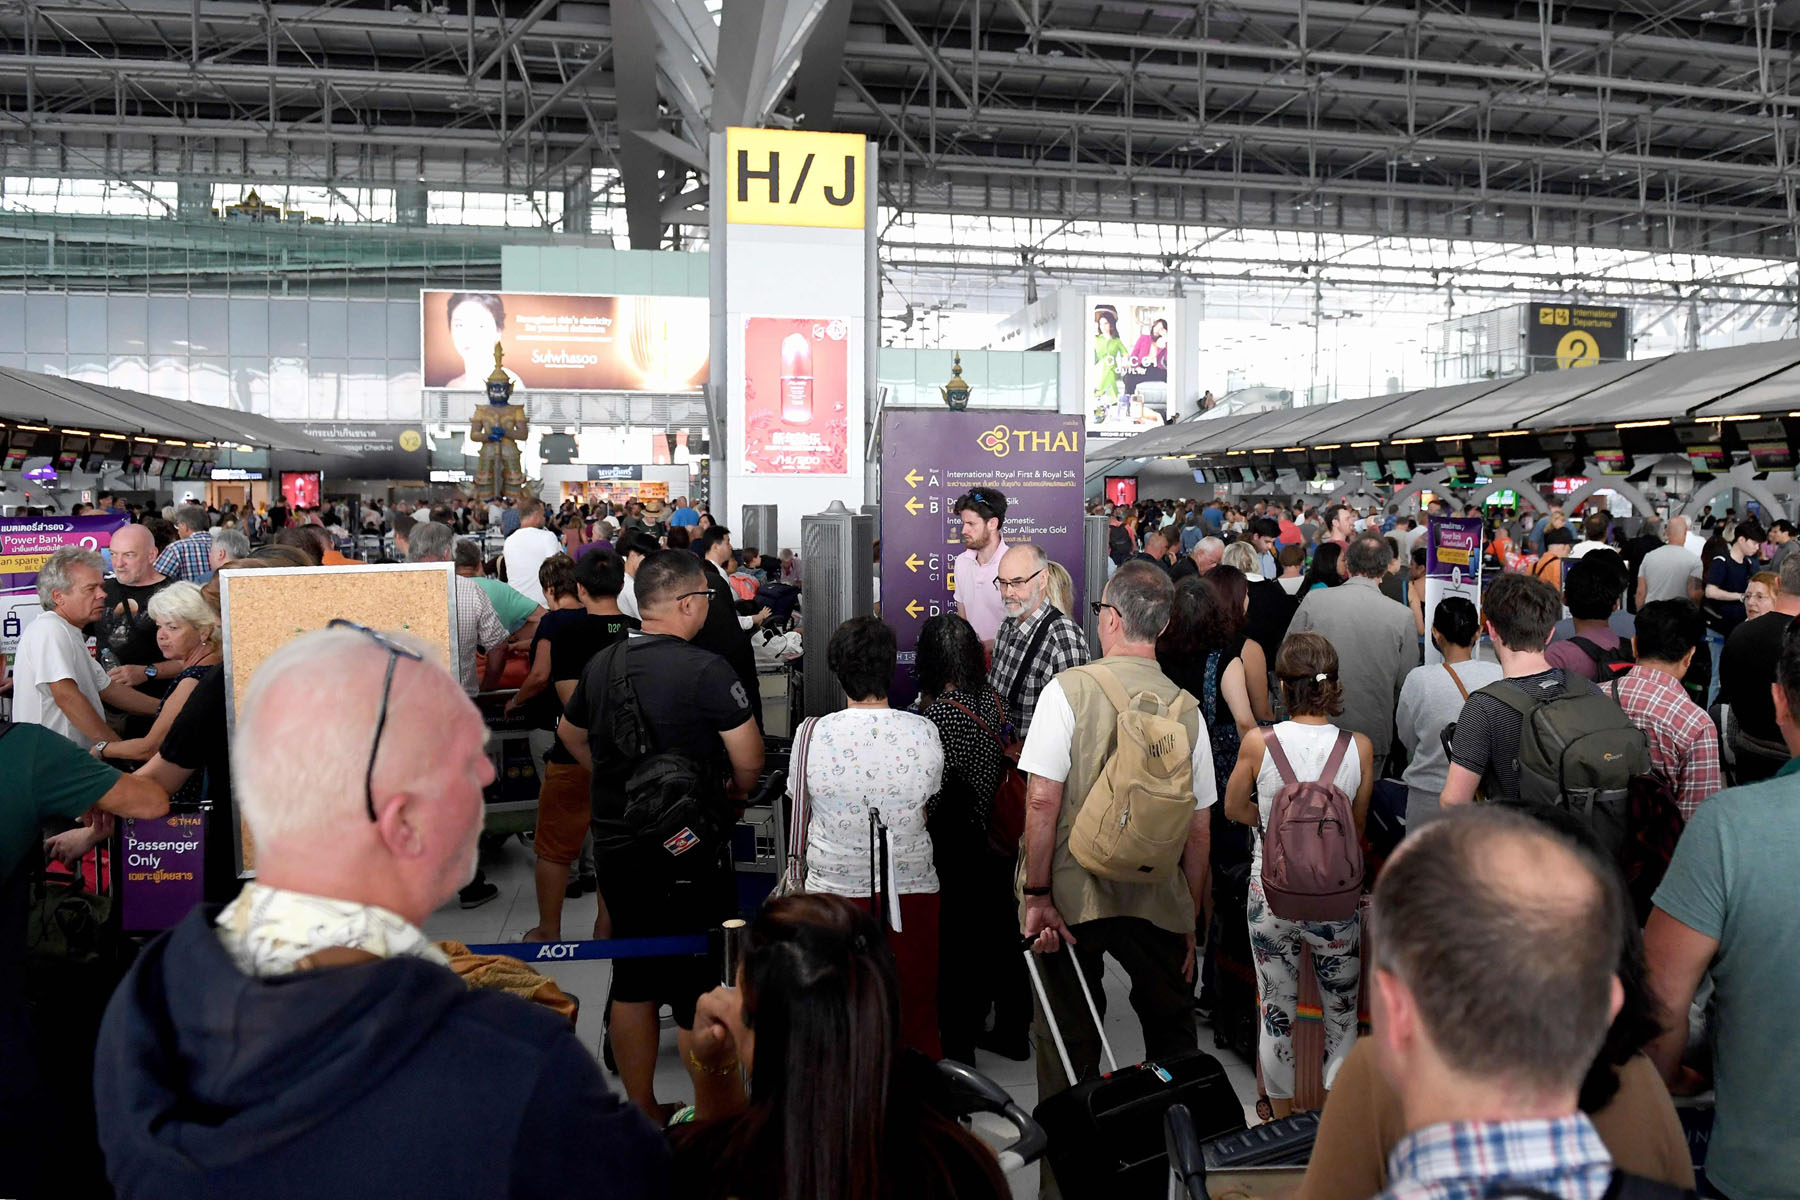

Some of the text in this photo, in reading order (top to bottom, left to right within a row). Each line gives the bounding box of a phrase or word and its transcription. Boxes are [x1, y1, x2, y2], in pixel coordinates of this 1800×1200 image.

[531, 349, 598, 365] Sulwhasoo
[1011, 429, 1079, 452] THAI
[928, 475, 939, 487] A
[946, 470, 1076, 480] International Royal First & Royal Silk
[1006, 497, 1019, 506] Silk
[929, 502, 939, 514] B
[1003, 526, 1067, 535] Star Alliance Gold
[4, 534, 64, 546] Power Bank
[14, 557, 39, 568] spare
[928, 558, 939, 571] C
[929, 573, 939, 582] C1
[929, 605, 940, 617] D
[729, 681, 749, 709] 8
[128, 838, 199, 854] Passenger
[128, 853, 161, 869] Only
[535, 943, 580, 959] AOT
